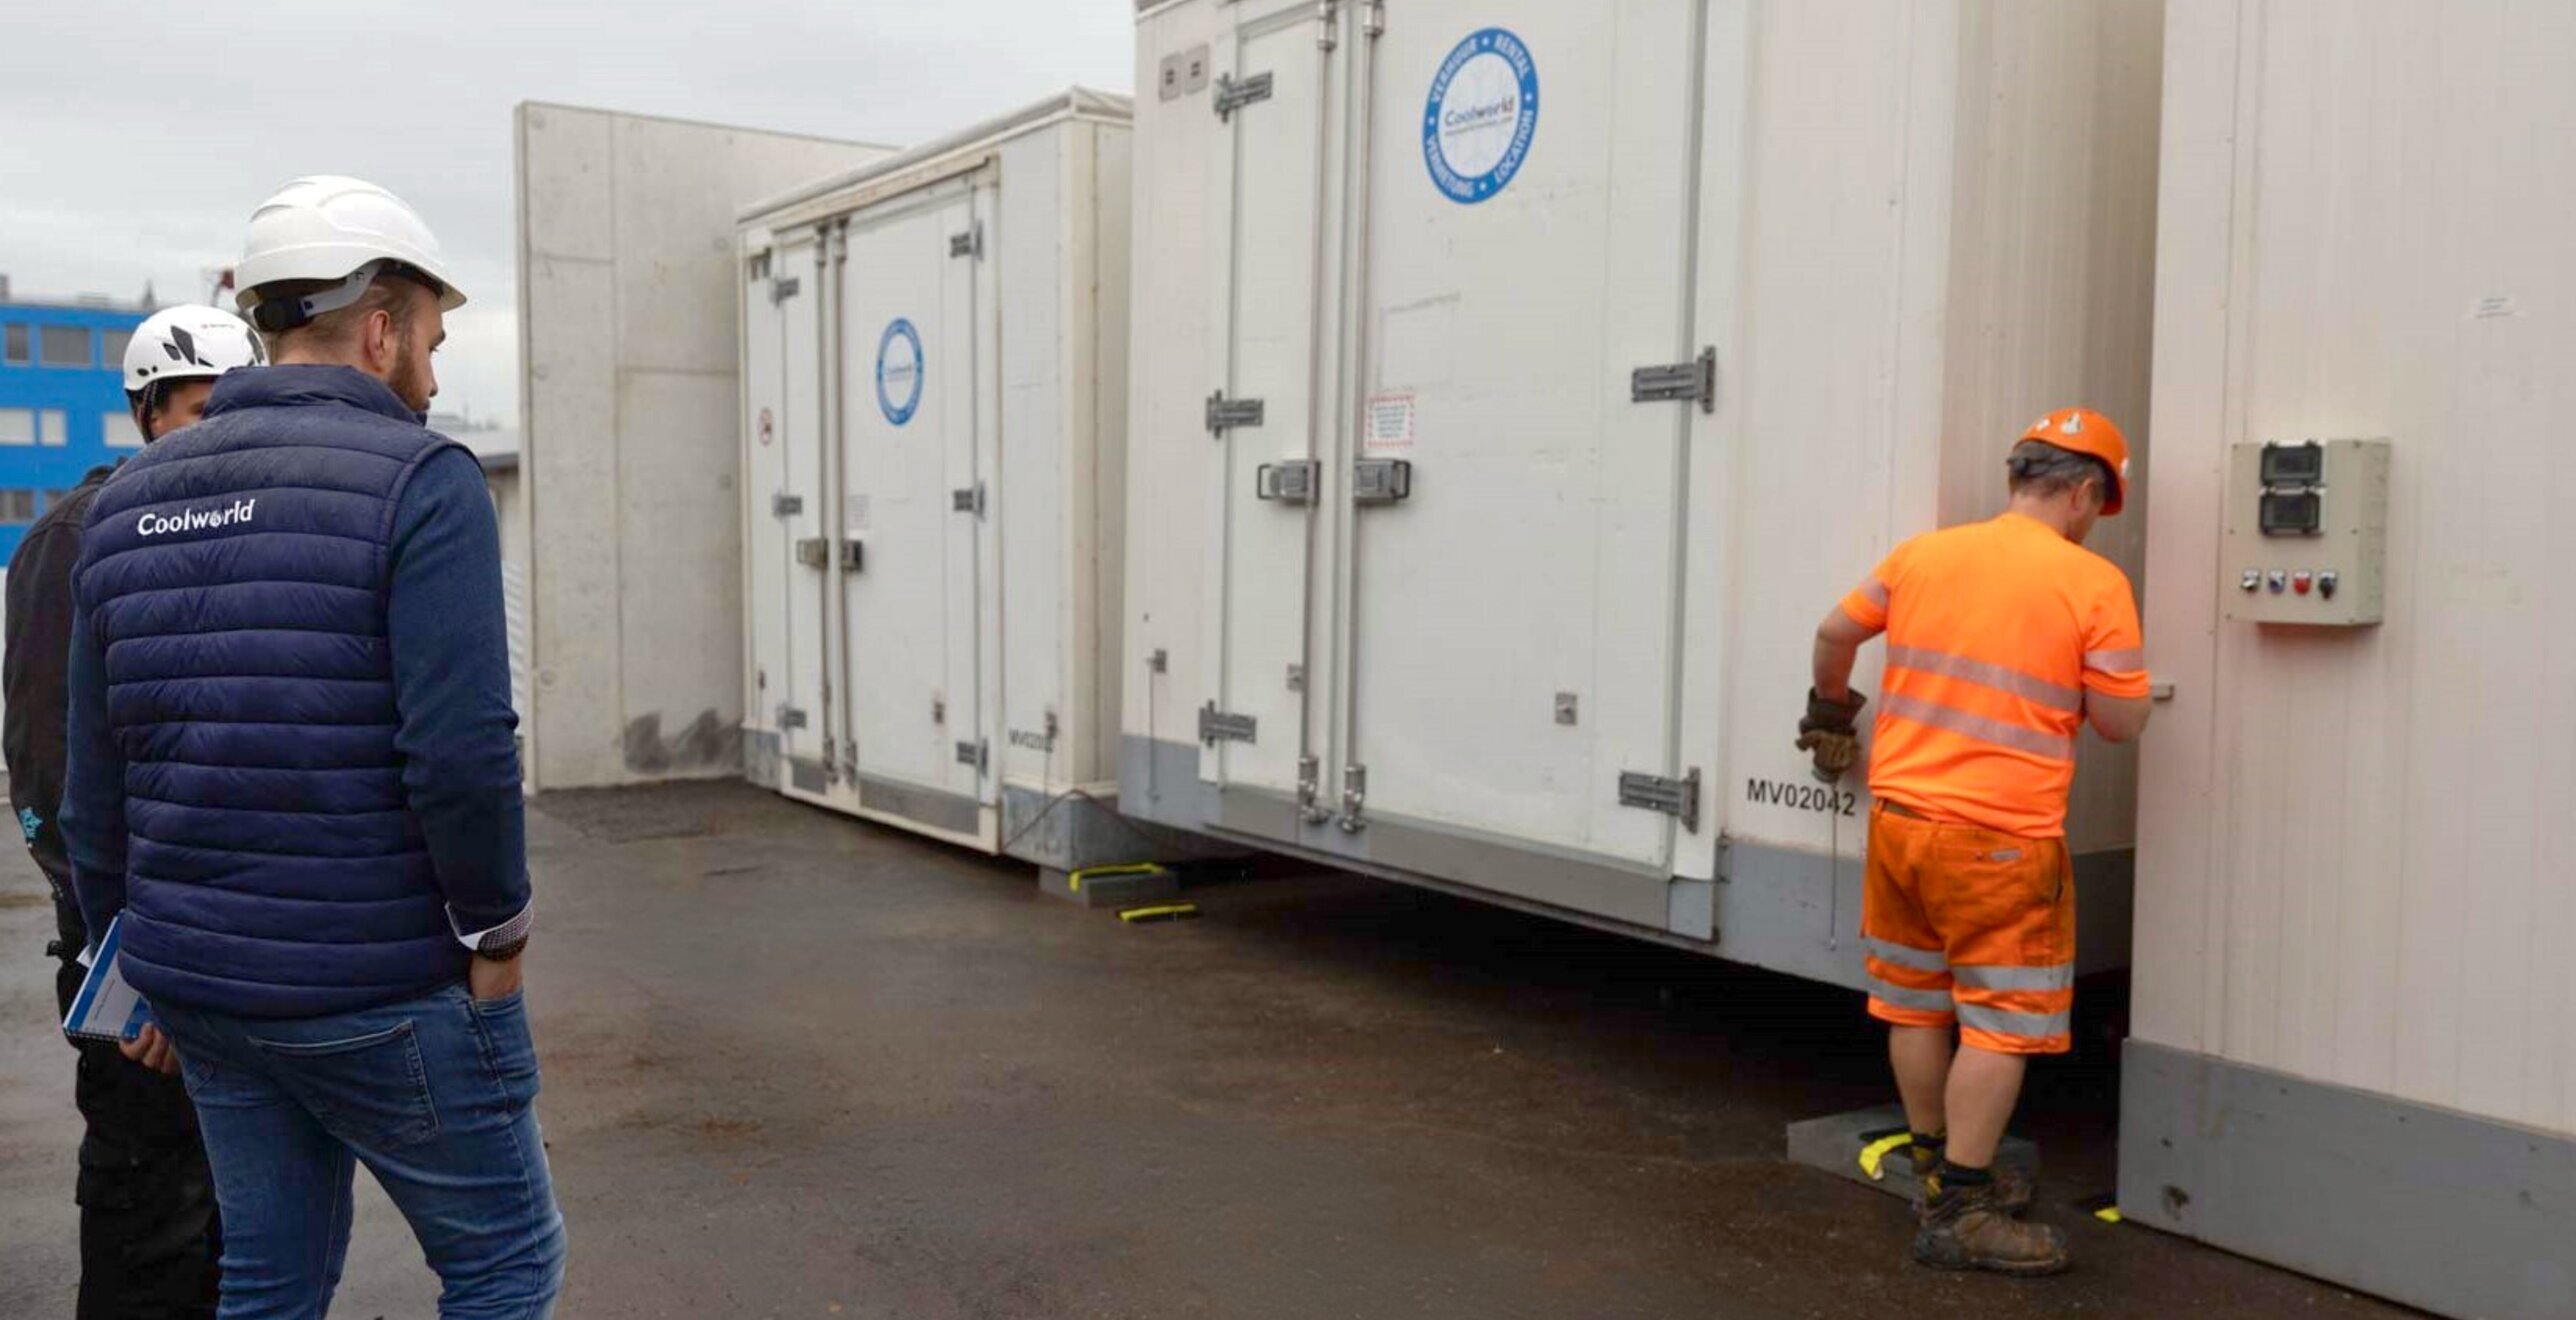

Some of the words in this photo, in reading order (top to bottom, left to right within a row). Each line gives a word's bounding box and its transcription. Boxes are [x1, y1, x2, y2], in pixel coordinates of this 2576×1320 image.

[1494, 34, 1531, 79] RENTAL
[1445, 96, 1514, 127] Coolworld
[1494, 110, 1533, 184] LOCATION
[137, 499, 256, 536] Coolworld
[1747, 778, 1856, 817] MV02042
